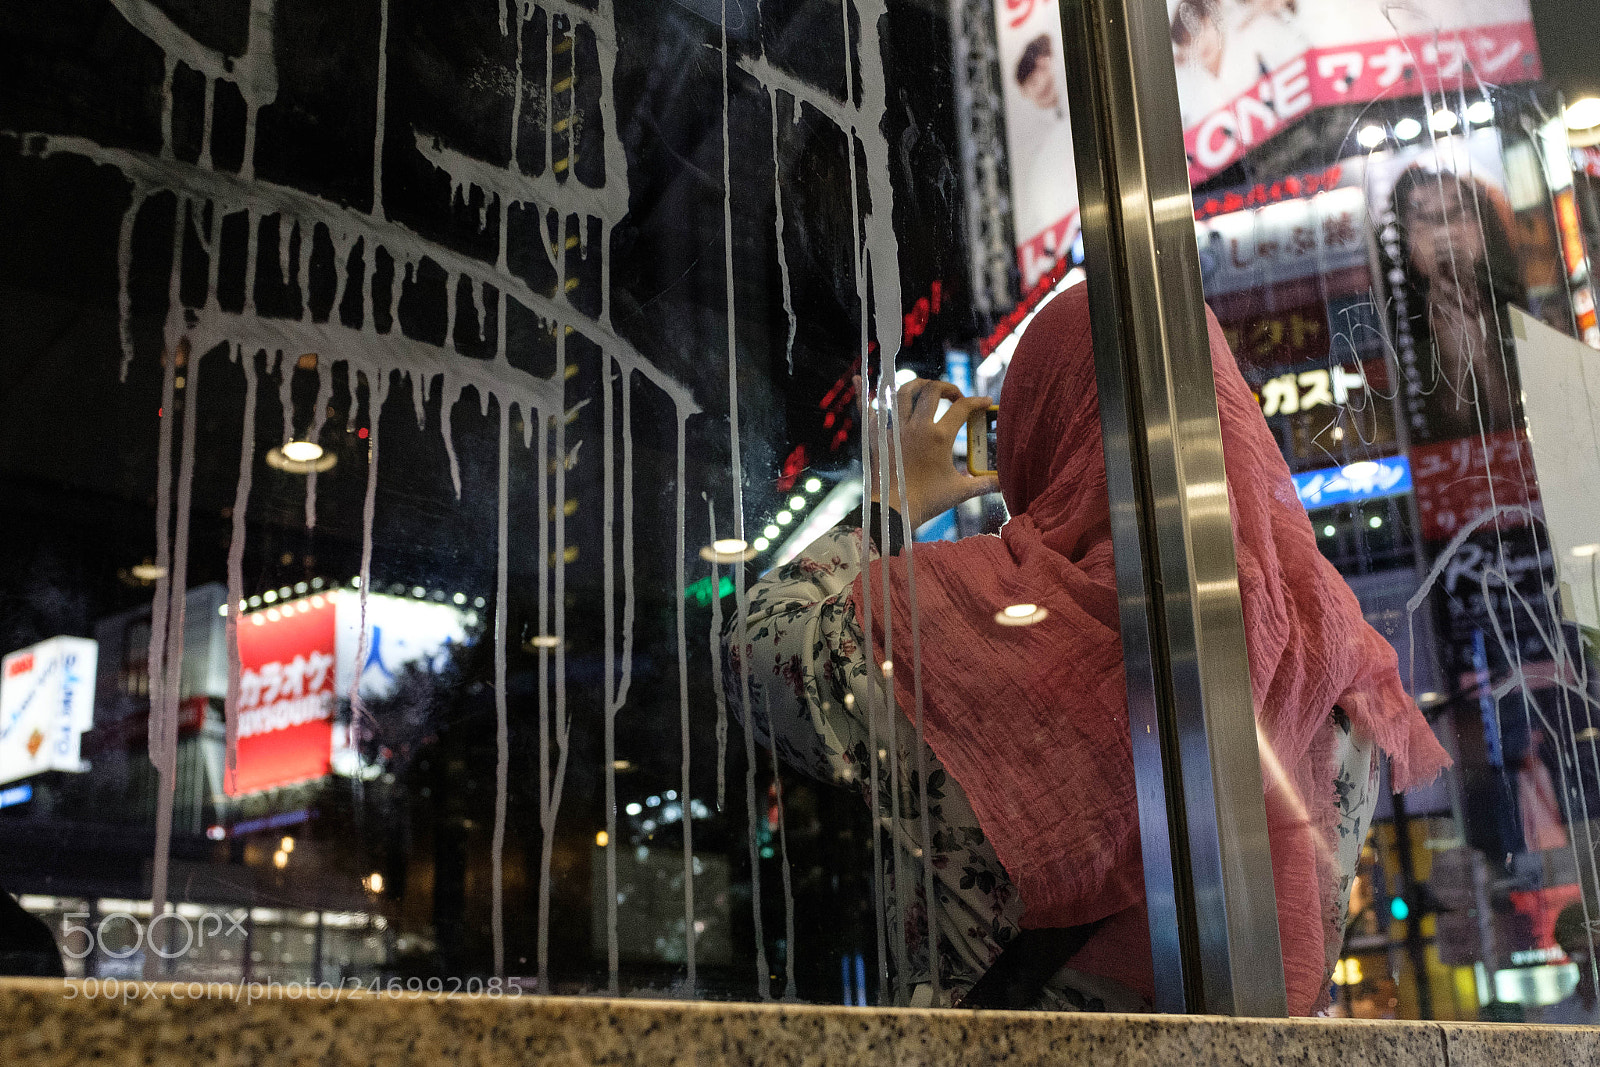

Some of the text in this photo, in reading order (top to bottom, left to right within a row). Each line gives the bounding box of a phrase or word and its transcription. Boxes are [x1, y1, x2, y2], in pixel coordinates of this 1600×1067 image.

[1262, 366, 1364, 417] ガスト
[238, 650, 333, 706] カラオケ
